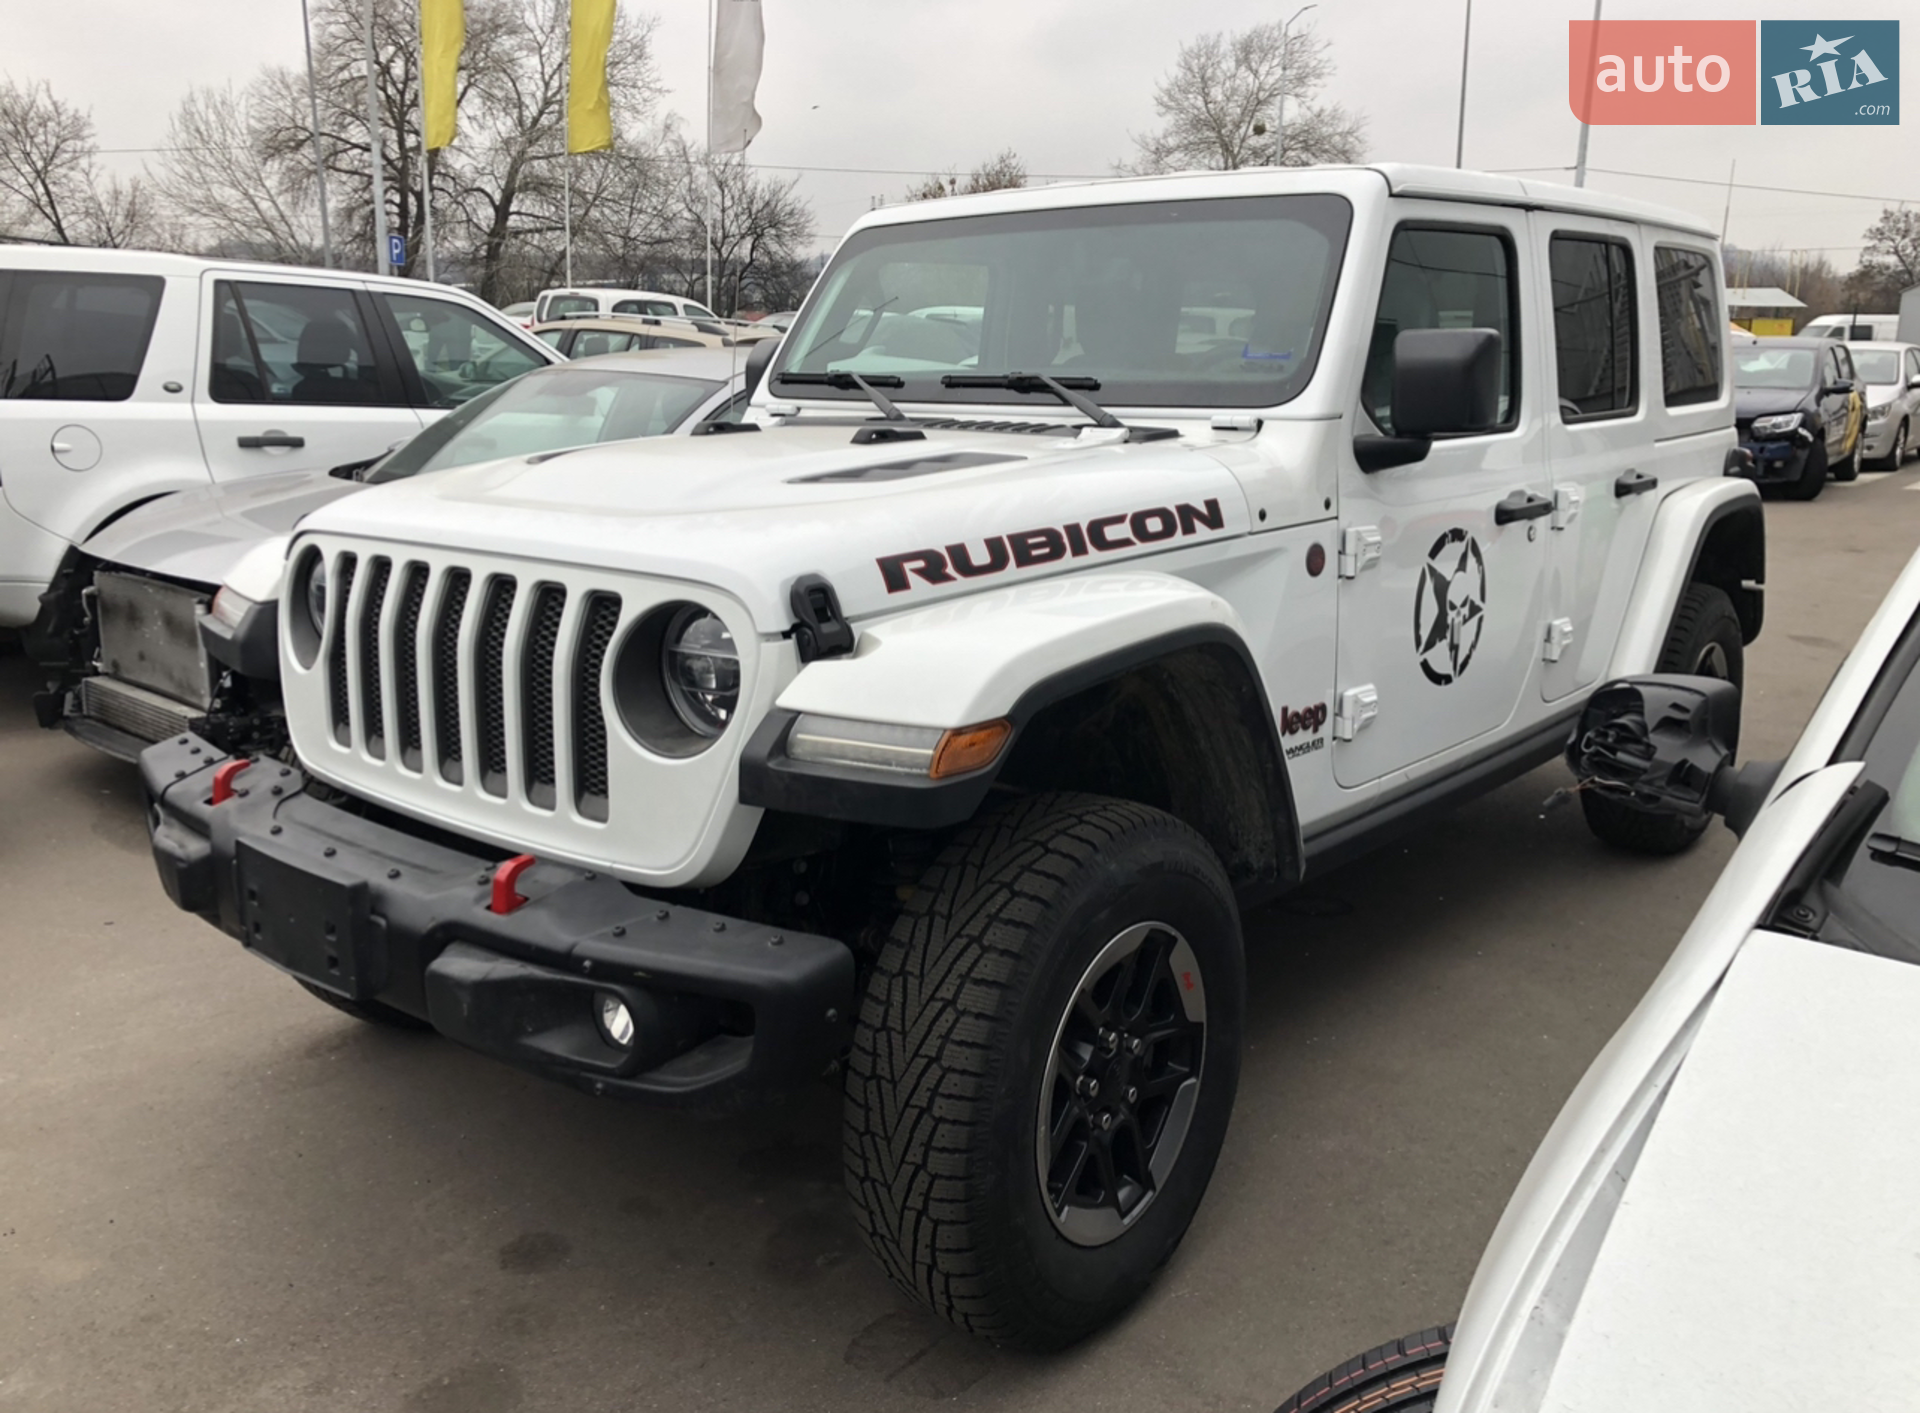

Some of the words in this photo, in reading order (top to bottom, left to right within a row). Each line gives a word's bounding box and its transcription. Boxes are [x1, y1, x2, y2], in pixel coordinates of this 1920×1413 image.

[392, 238, 401, 261] P
[875, 497, 1225, 594] RUBICON
[1281, 702, 1327, 737] Jeep
